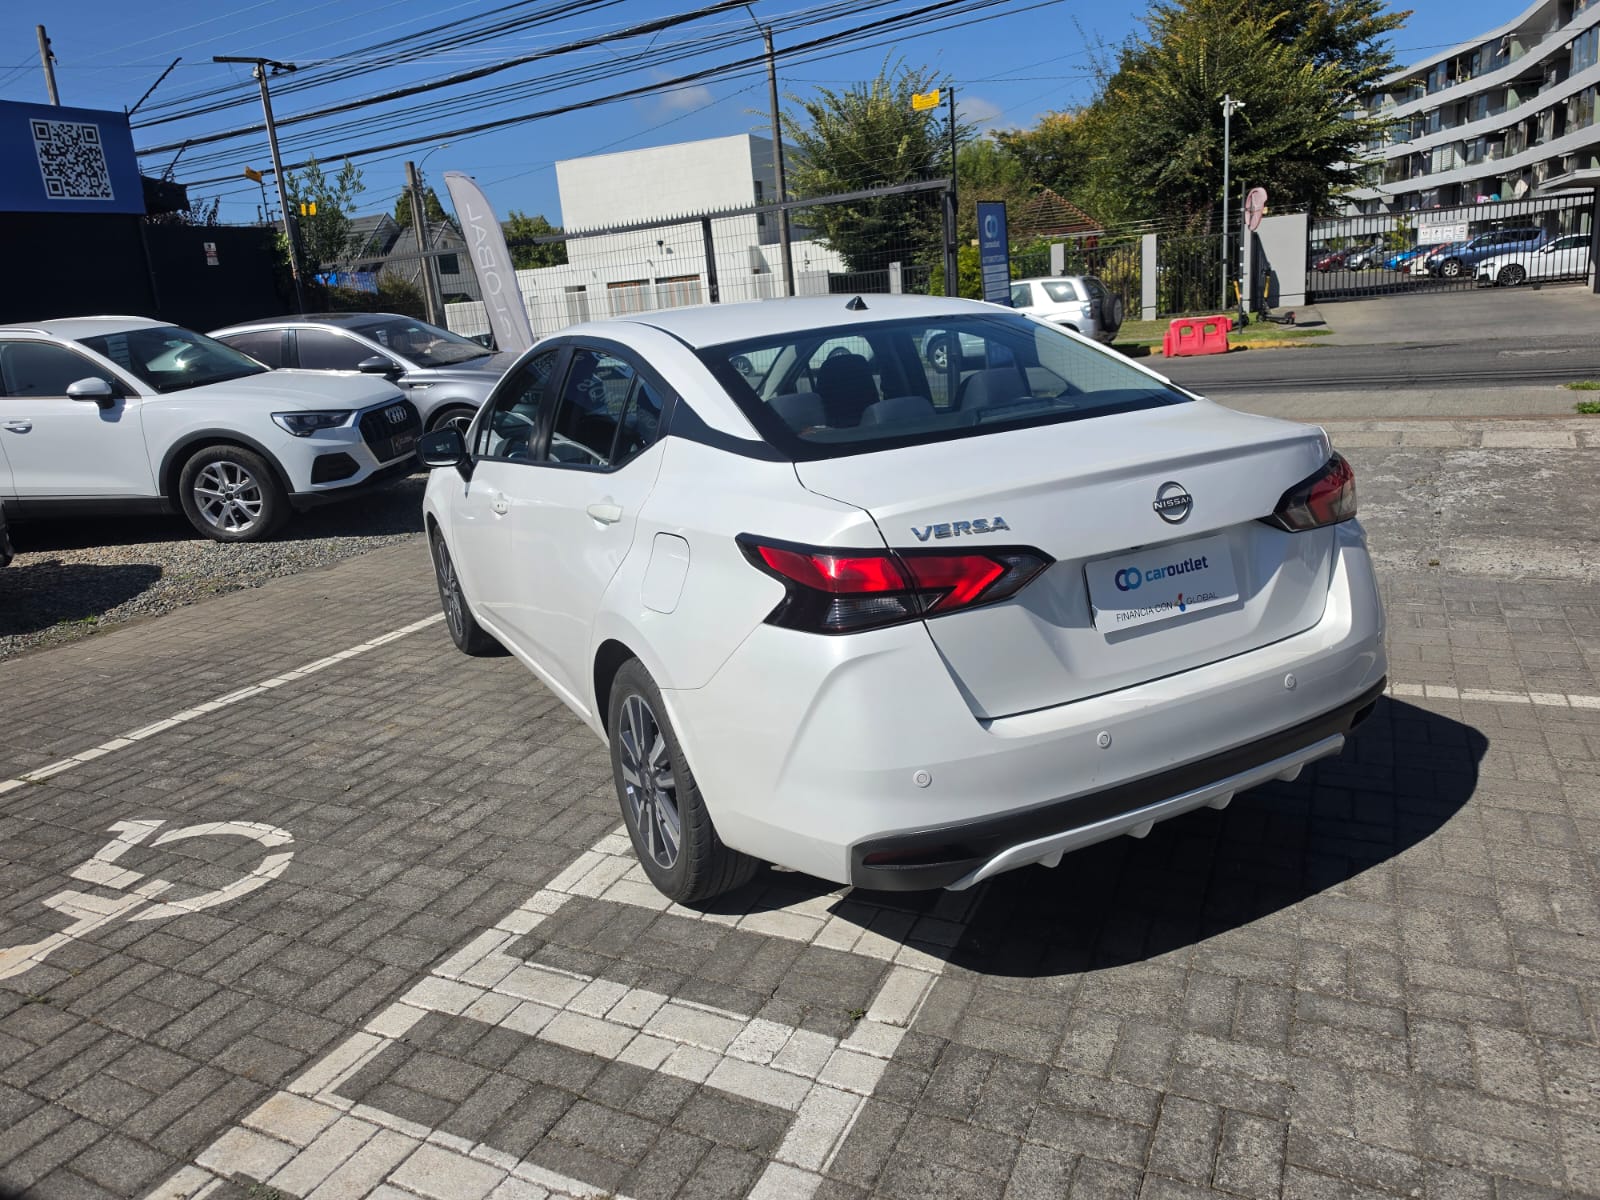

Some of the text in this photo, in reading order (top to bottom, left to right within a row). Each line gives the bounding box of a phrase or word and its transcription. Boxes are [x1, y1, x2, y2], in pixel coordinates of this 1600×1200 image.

[1153, 494, 1192, 511] NISSAN
[911, 516, 1011, 542] VERSA
[1145, 555, 1209, 583] caroutlet
[1116, 591, 1219, 622] FINANCIA CON GLOBAL
